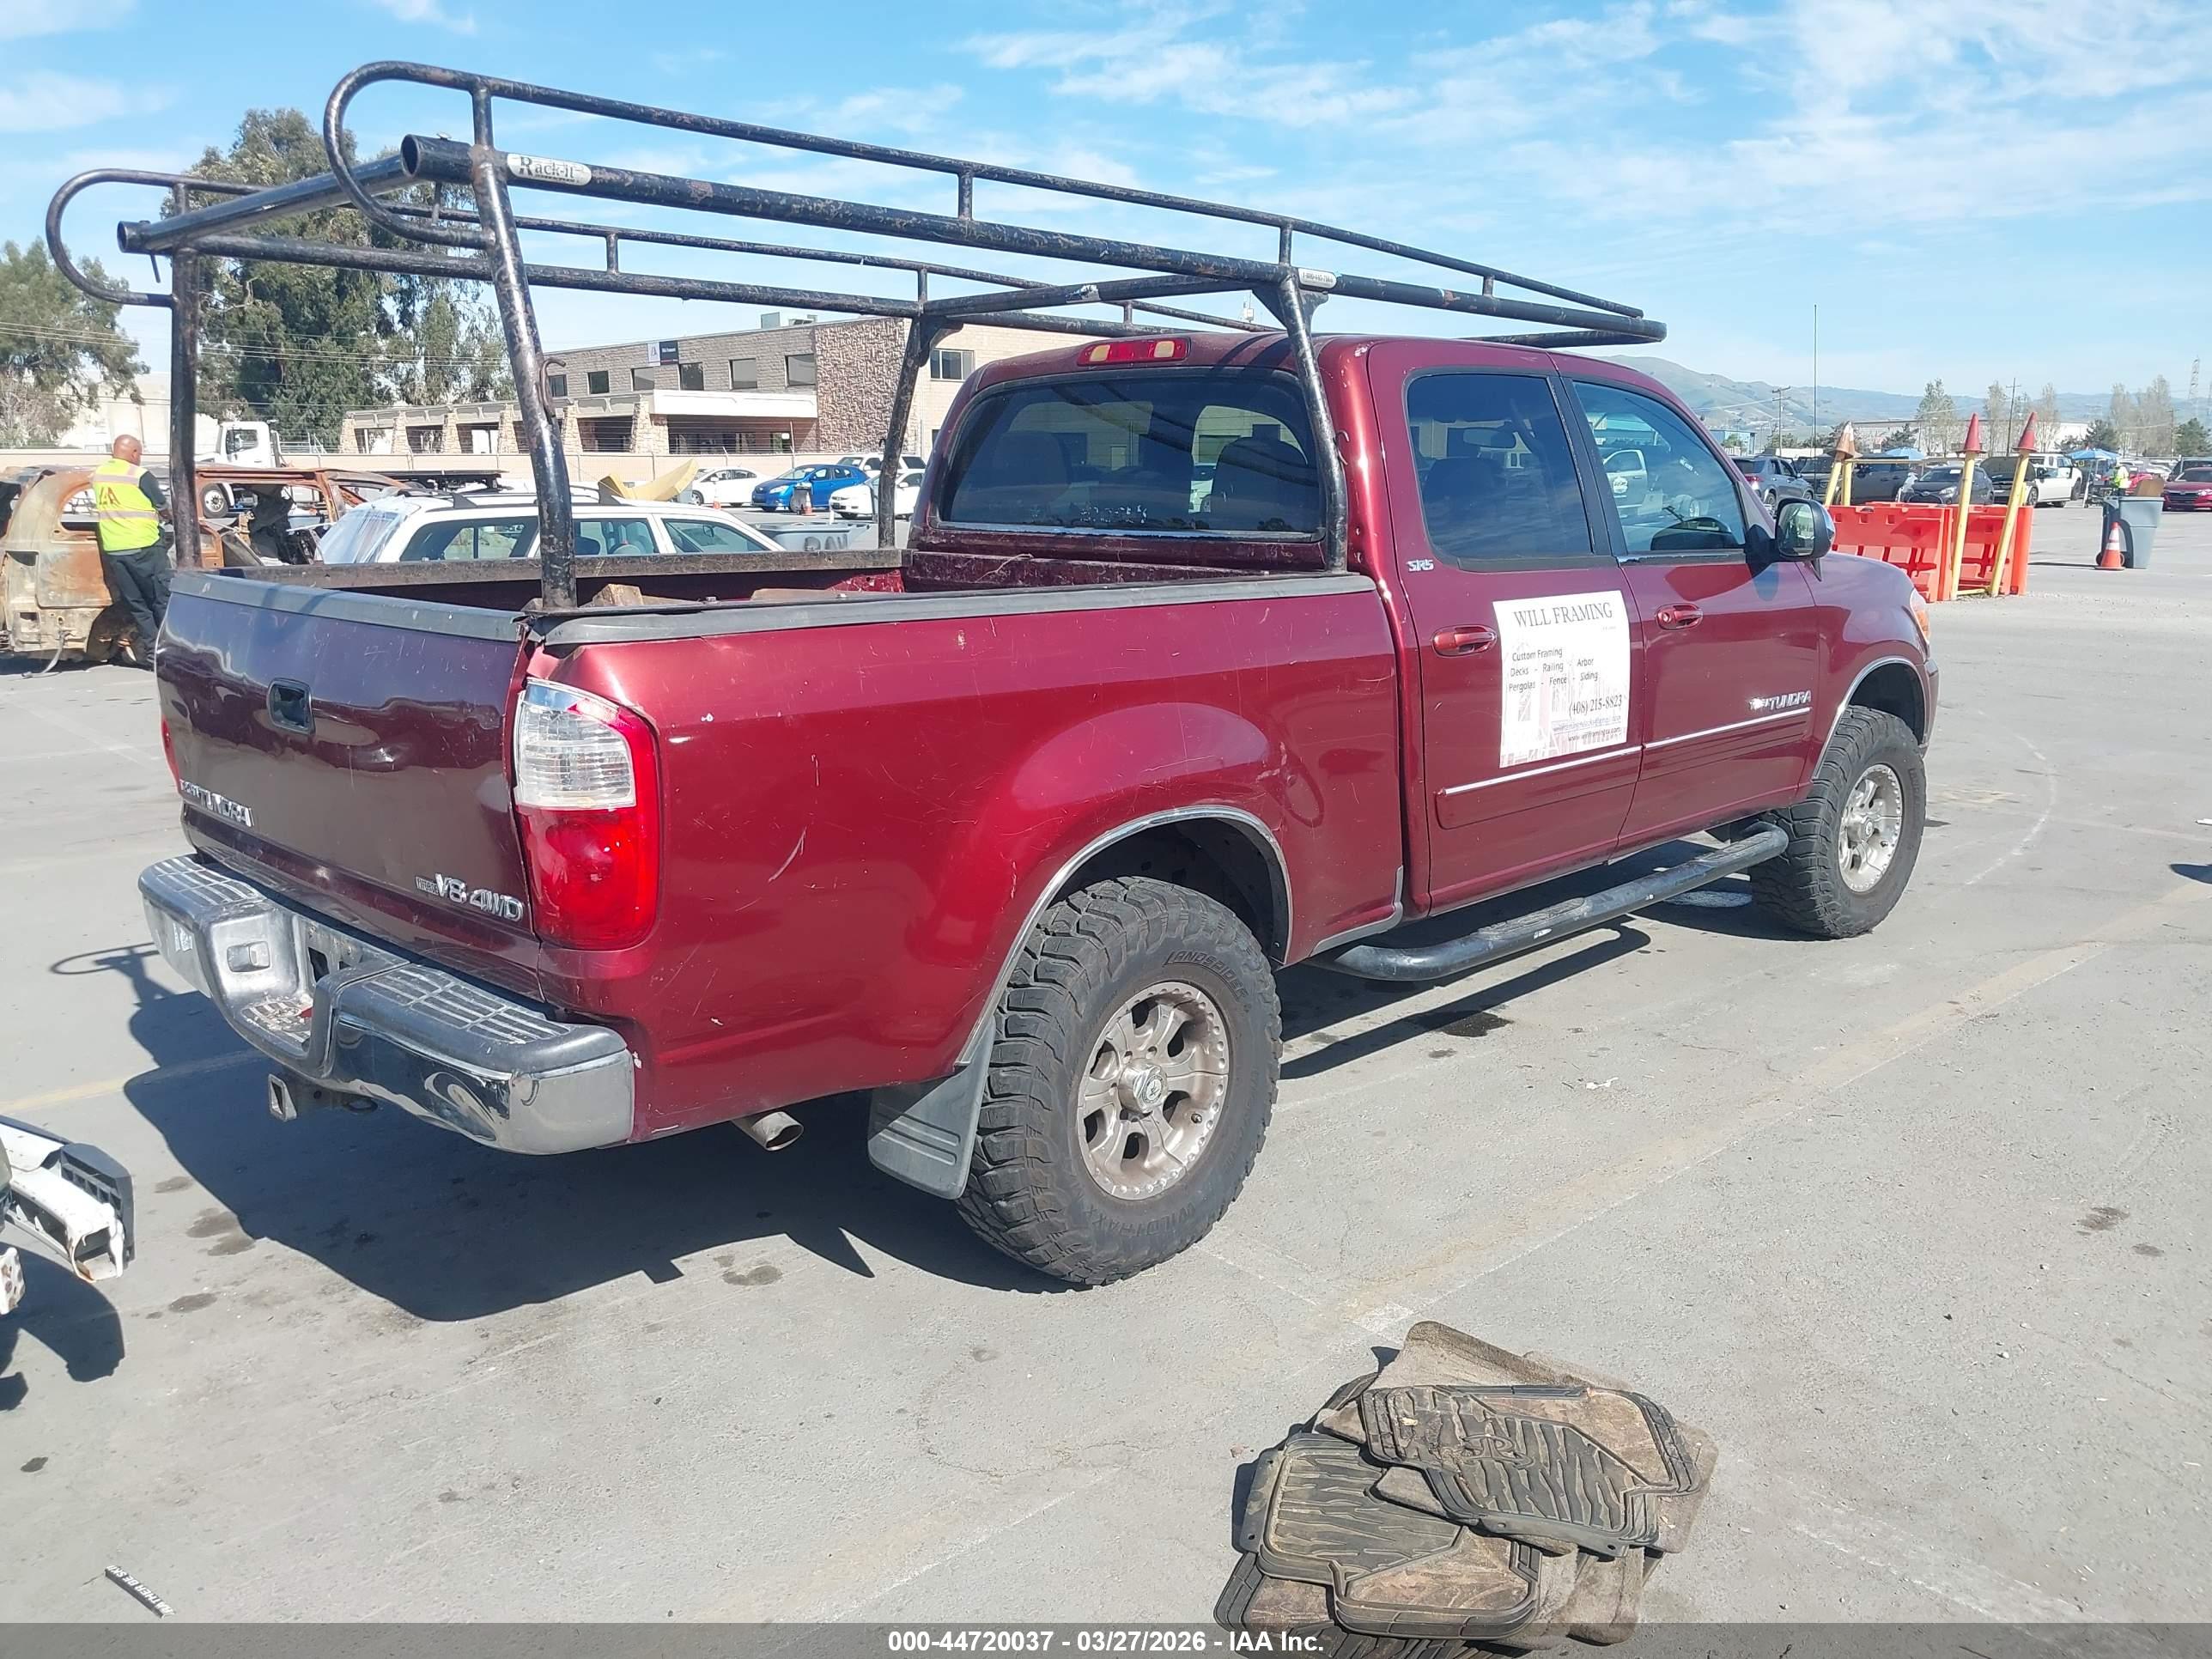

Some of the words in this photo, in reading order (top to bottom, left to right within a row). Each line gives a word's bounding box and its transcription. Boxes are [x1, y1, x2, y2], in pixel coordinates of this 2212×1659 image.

[1406, 558, 1434, 572] SR5
[1514, 609, 1552, 627] WILL
[1553, 602, 1613, 624] FRAMING
[1512, 652, 1536, 662] Custom
[1537, 647, 1563, 659] Framing
[1510, 666, 1528, 678] Decks
[1542, 662, 1564, 673] Railing
[1577, 658, 1594, 667] Arbor
[1509, 681, 1536, 693] Pergolas
[1549, 677, 1567, 686] Fence
[1580, 672, 1598, 682] Siding
[198, 787, 255, 827] TUNDRA
[434, 872, 467, 903] V8
[469, 889, 523, 921] 4WD
